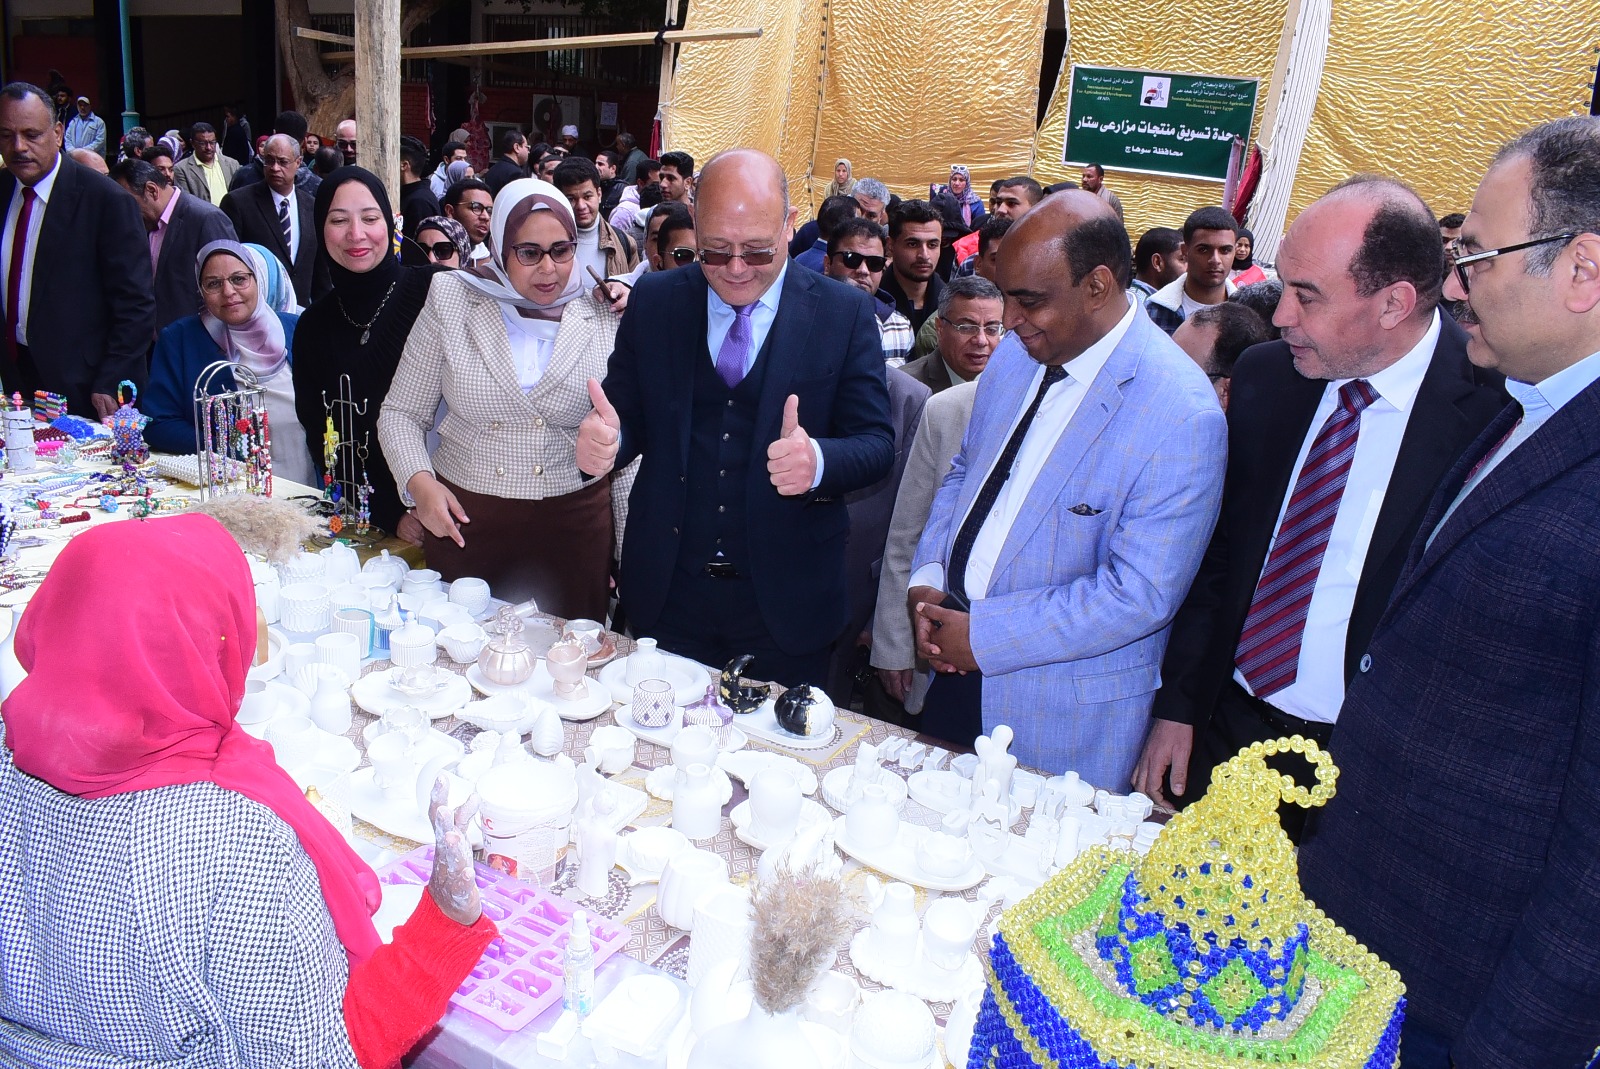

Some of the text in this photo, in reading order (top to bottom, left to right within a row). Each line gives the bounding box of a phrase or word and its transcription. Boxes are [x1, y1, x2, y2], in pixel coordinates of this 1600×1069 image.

[1075, 116, 1098, 129] ستار
[1138, 121, 1175, 137] منتجات
[1176, 125, 1211, 142] تسويق
[1125, 145, 1183, 157] محافظة سوهاج
